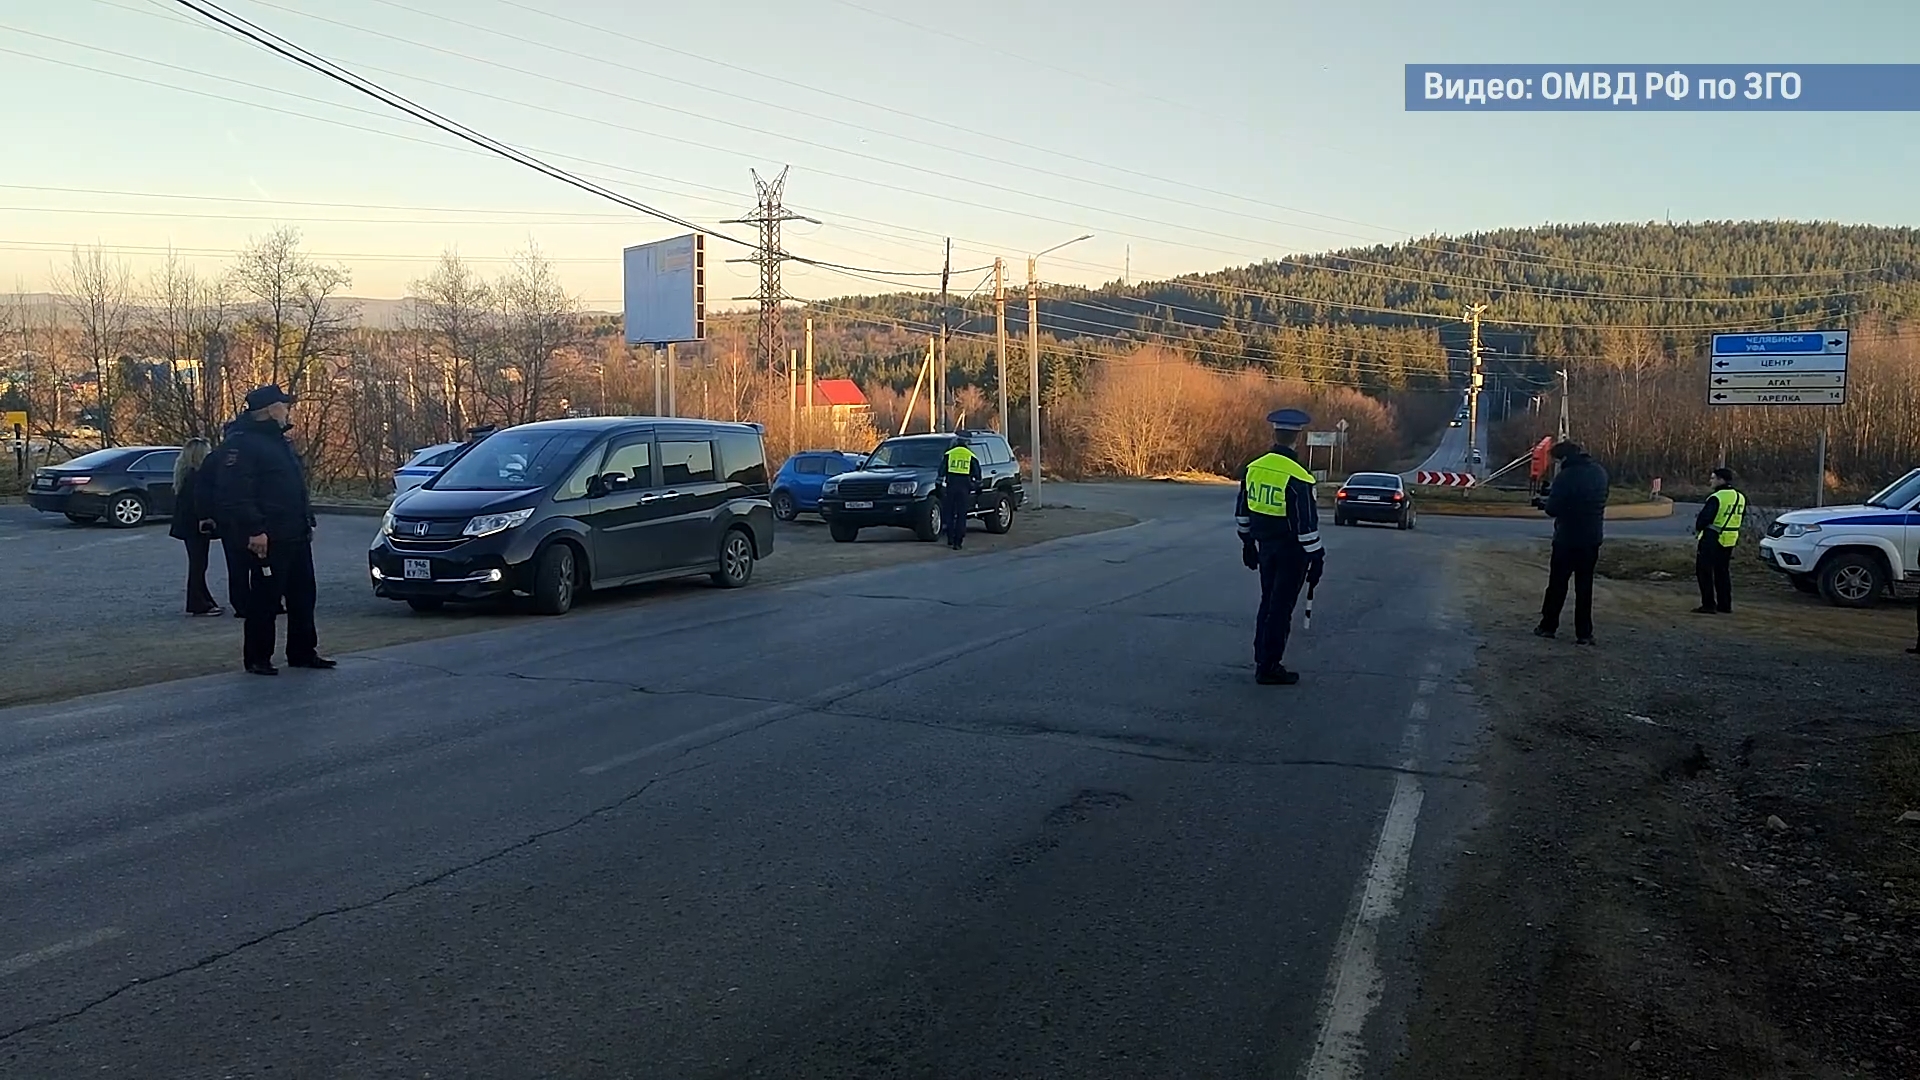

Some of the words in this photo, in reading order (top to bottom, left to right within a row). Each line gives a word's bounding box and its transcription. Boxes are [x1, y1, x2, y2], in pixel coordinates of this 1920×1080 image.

[1746, 335, 1804, 344] ЧЕЛЯБИНСК
[1761, 359, 1794, 367] ЦЕНТР
[950, 459, 969, 469] ДПС
[1248, 481, 1282, 506] ДПС
